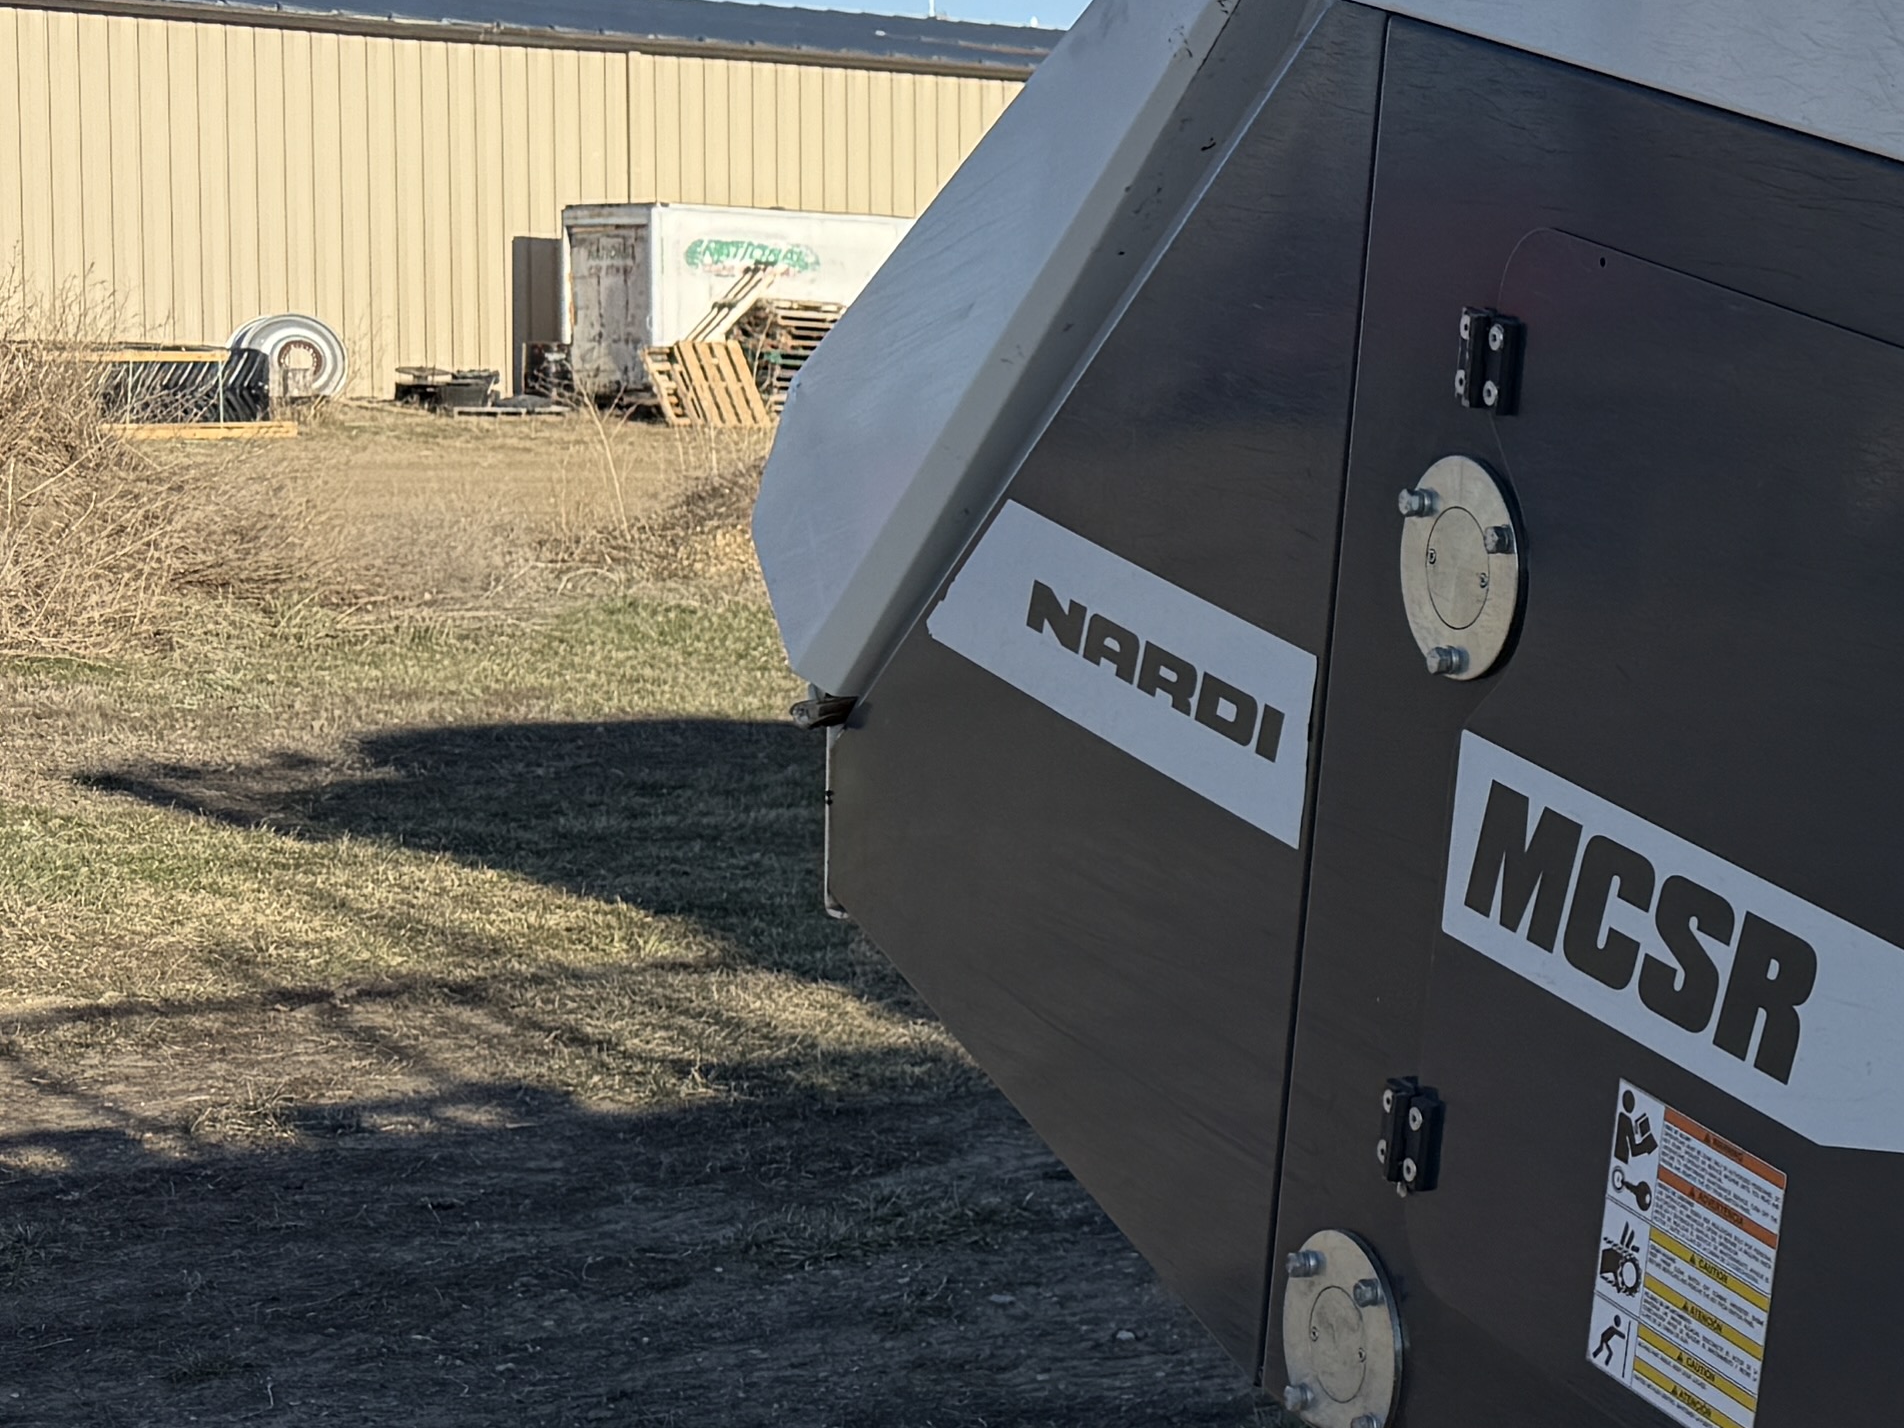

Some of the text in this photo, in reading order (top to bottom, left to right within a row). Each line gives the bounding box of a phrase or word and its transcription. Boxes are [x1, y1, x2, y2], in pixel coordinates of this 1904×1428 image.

[1025, 579, 1285, 763] NARDI
[1463, 779, 1818, 1086] MCSR
[1698, 1258, 1728, 1284] CAUTION
[1689, 1303, 1722, 1333] ATENCIÓN
[1686, 1356, 1715, 1383] CAUTION
[1678, 1387, 1711, 1418] ATENCIÓN
